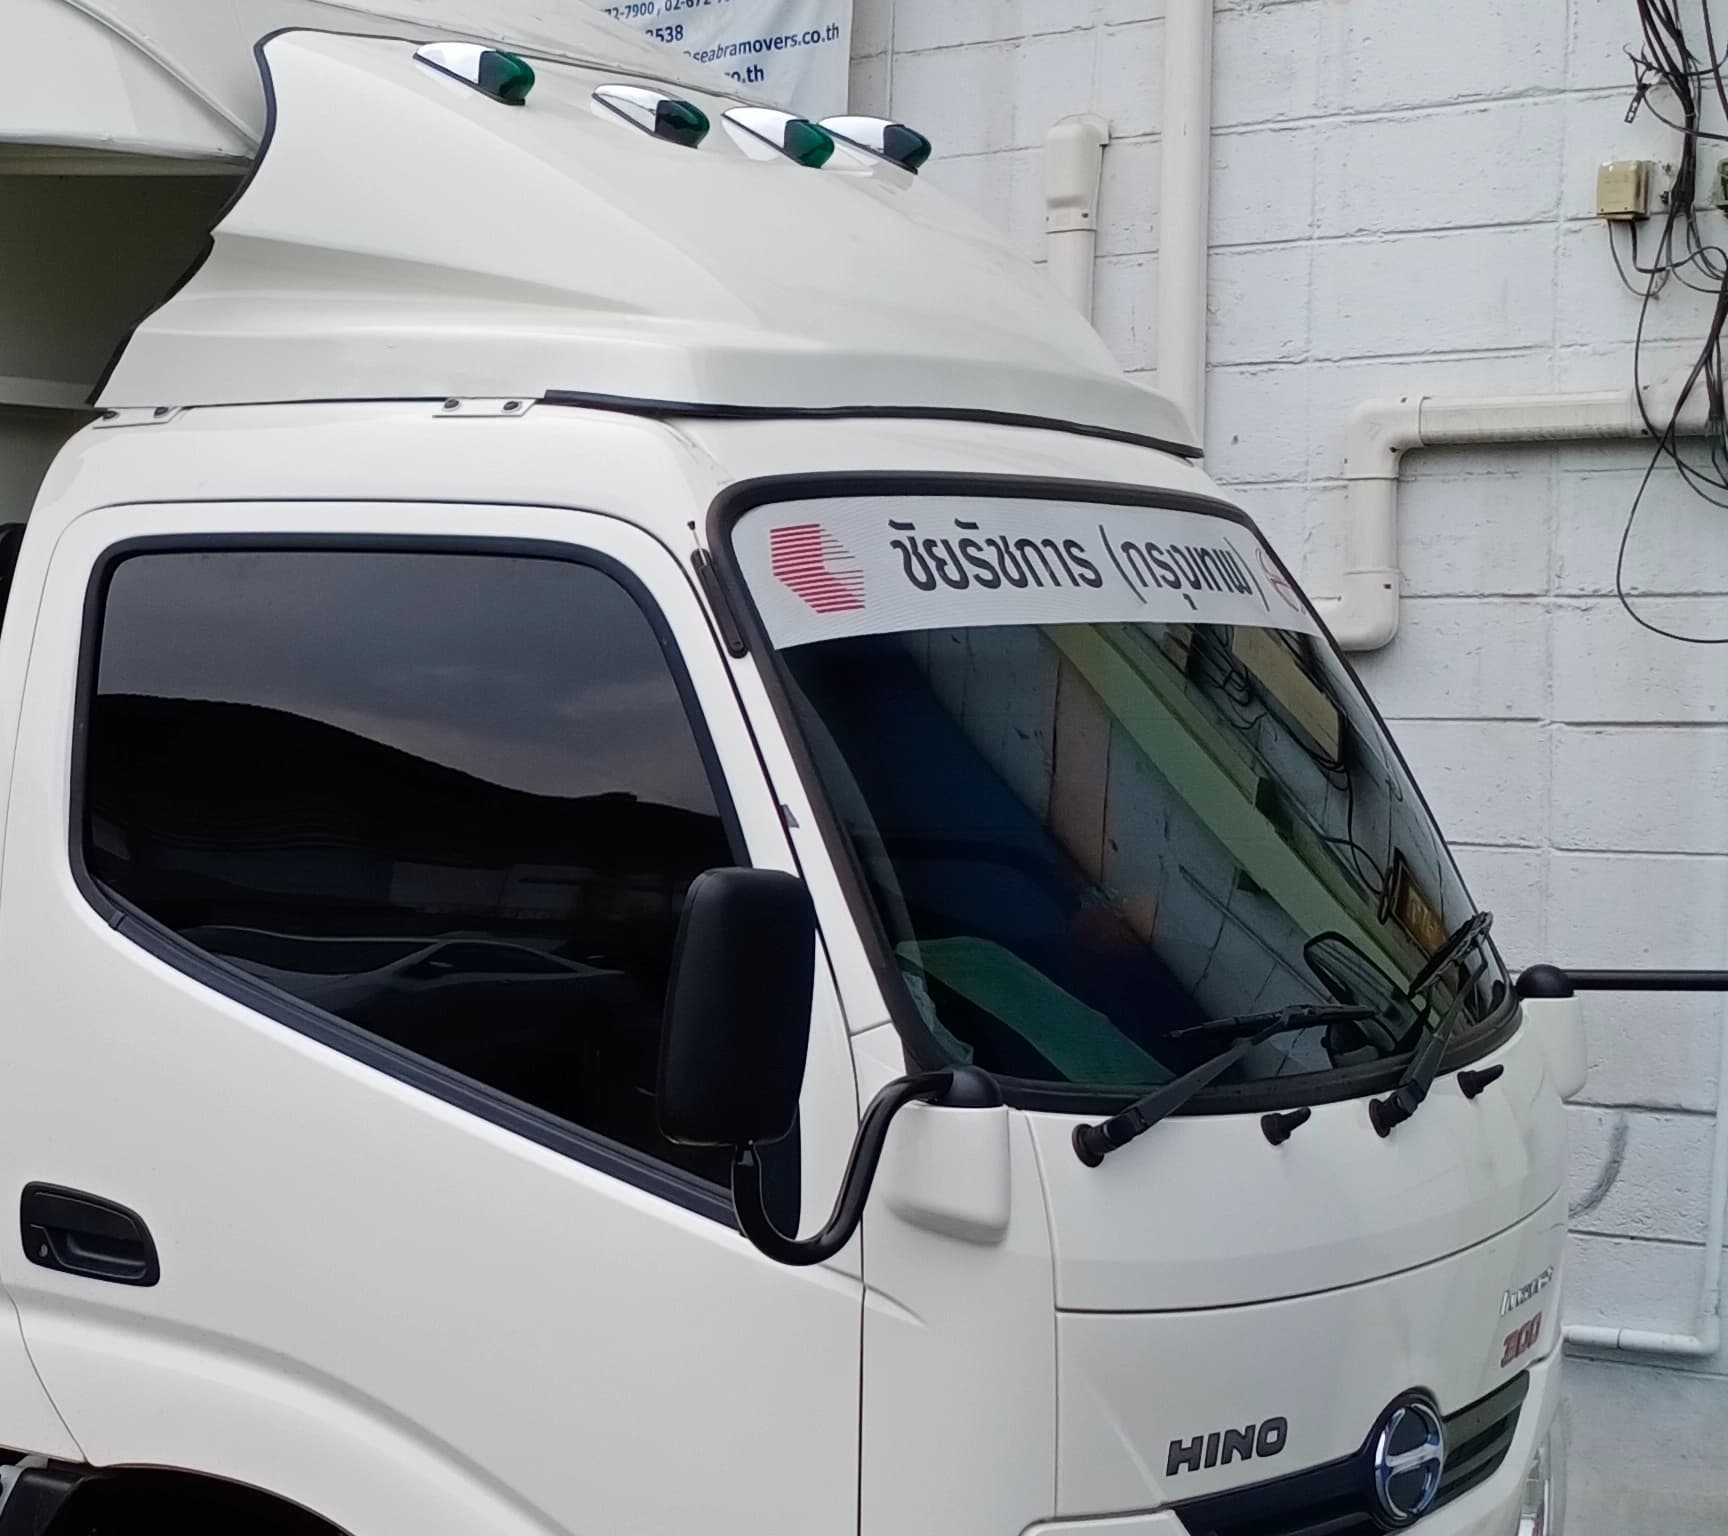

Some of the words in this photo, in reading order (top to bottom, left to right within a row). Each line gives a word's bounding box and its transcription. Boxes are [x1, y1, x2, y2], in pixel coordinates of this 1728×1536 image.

[888, 518, 1104, 592] ชัยรัชการ
[1165, 1416, 1288, 1477] HINO
